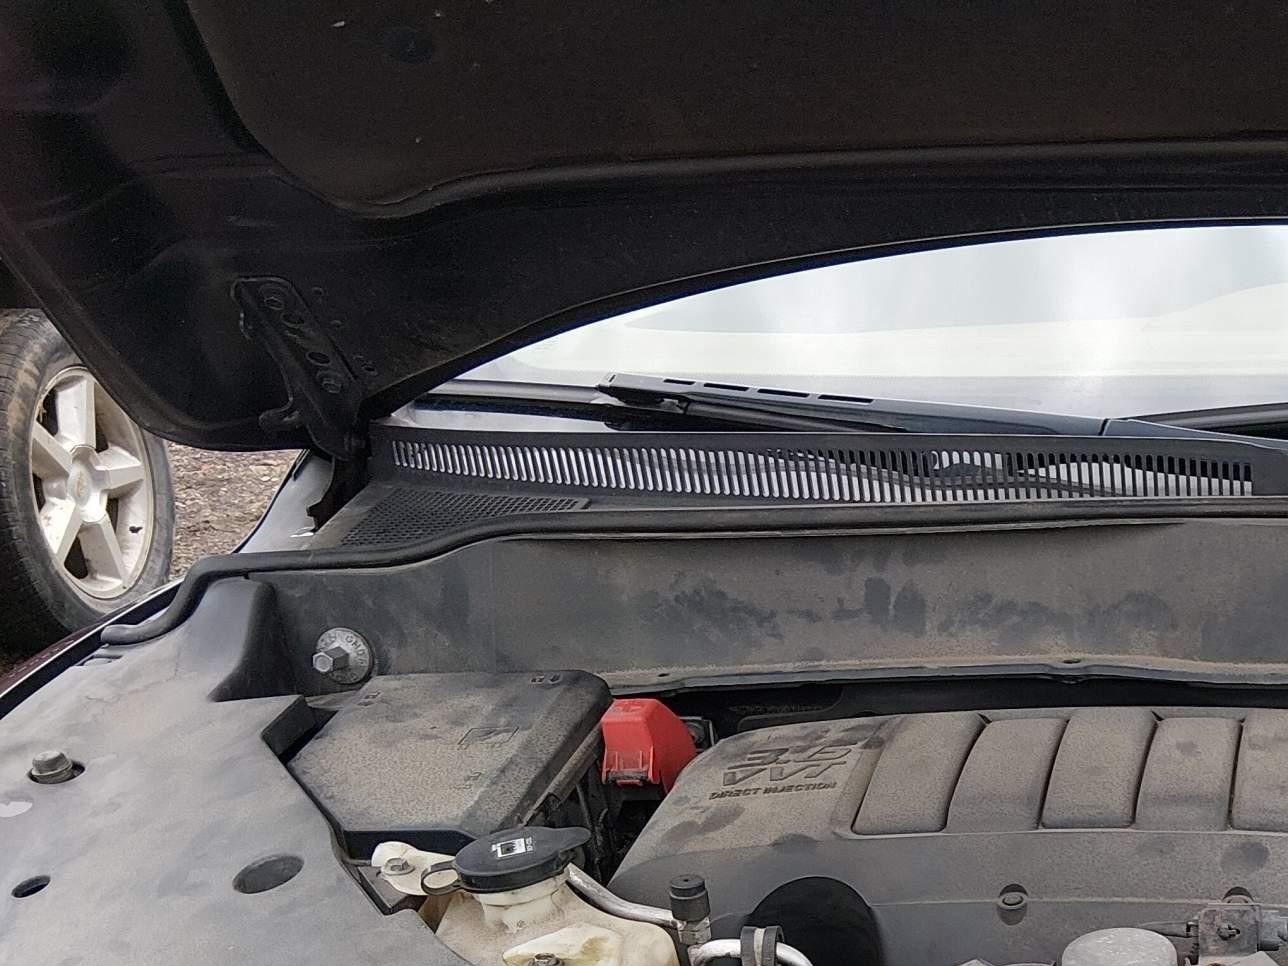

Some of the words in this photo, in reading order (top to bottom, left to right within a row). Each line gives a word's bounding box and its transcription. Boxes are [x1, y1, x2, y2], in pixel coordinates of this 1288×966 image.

[727, 743, 853, 770] 3.6
[722, 761, 847, 786] VVT
[709, 787, 762, 800] DIRECT
[762, 781, 838, 795] INJECTION
